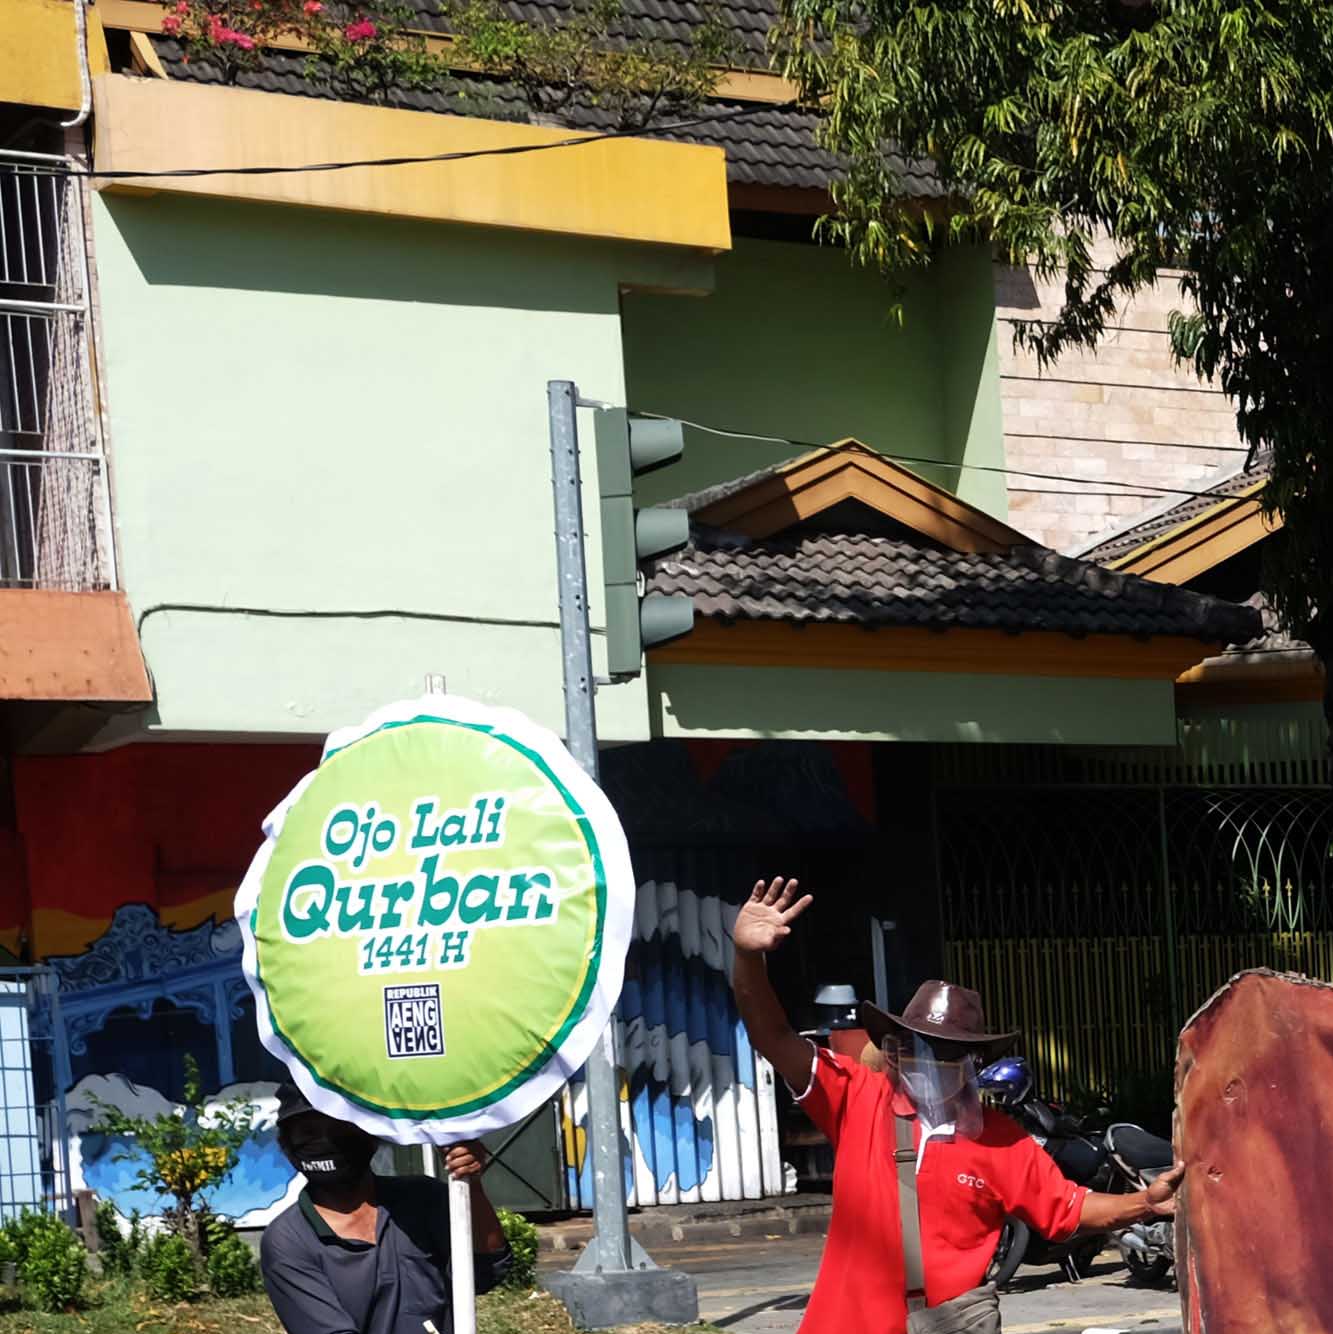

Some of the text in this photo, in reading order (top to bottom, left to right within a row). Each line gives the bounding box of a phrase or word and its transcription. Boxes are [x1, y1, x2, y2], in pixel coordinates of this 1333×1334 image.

[325, 797, 505, 867] Ojo Lali
[283, 853, 553, 938] Qurban
[363, 930, 469, 969] 1441 H
[386, 986, 438, 1000] REPUBLIK
[391, 1000, 436, 1028] AENG
